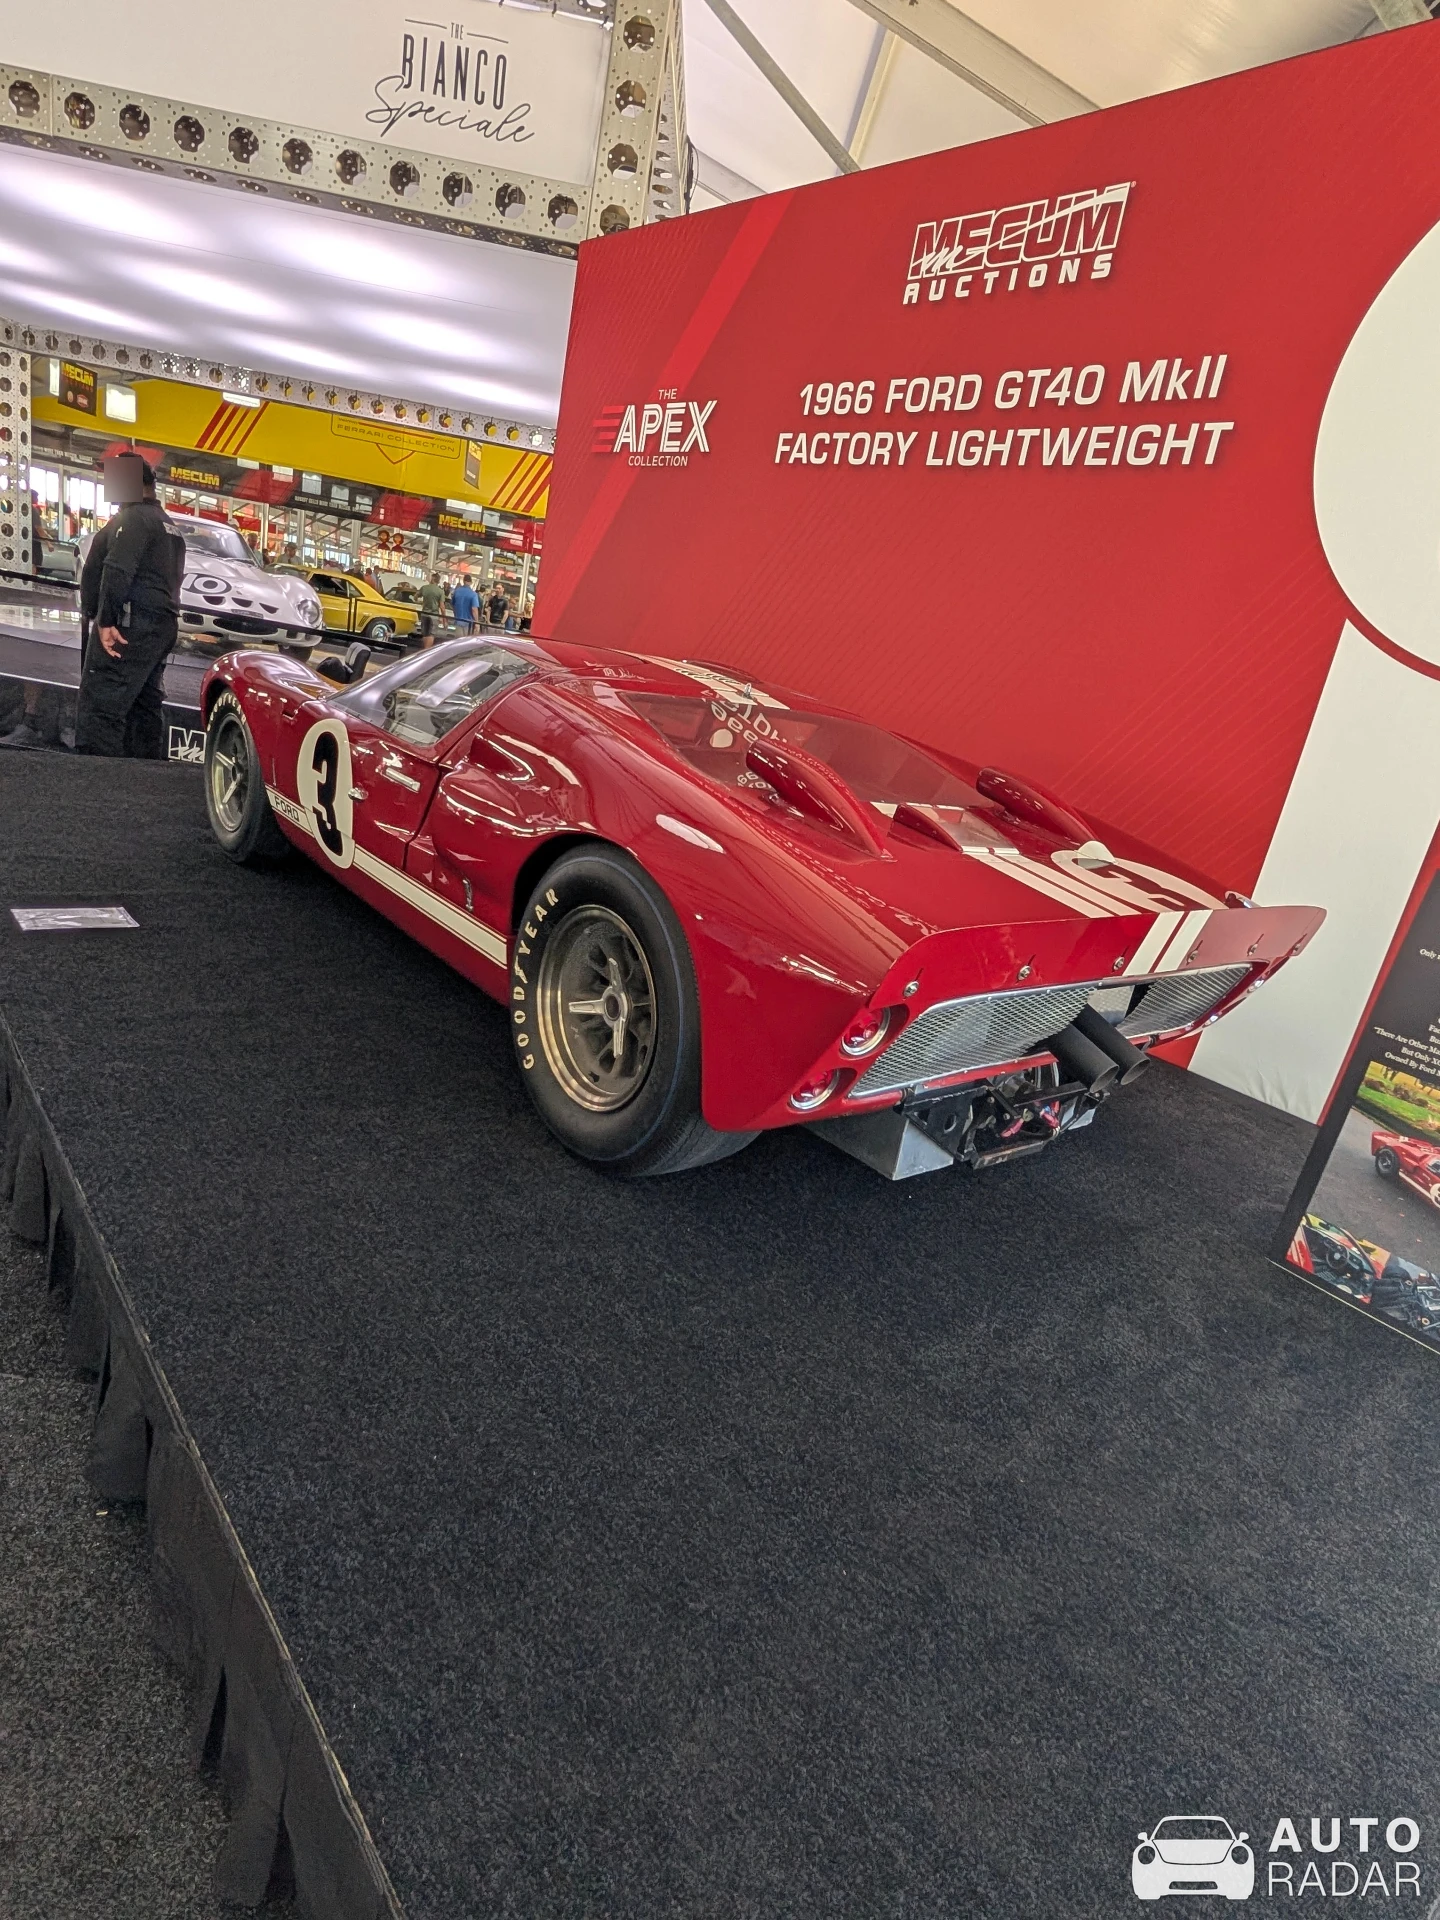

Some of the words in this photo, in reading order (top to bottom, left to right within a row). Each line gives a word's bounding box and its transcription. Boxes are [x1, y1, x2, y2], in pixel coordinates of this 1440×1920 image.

[450, 22, 464, 40] THE
[401, 33, 507, 110] BIANCO
[365, 75, 535, 142] Speciale
[907, 181, 1131, 281] MECUM
[902, 252, 1114, 305] AUCTIONS
[658, 388, 678, 400] THE
[800, 380, 875, 416] 1966
[884, 373, 983, 413] FORD
[994, 363, 1106, 409] GT40
[337, 423, 384, 438] FERRARI
[387, 434, 455, 453] COLLECTION
[612, 399, 718, 453] APEX
[774, 431, 918, 466] FACTORY
[925, 421, 1235, 467] LIGHTWEIGHT
[170, 466, 220, 486] MECUM
[628, 455, 688, 467] COLLECTION
[438, 513, 486, 534] MECUM
[274, 796, 300, 822] FORD
[311, 731, 343, 857] 3
[512, 888, 560, 1070] GOODYEAR
[1395, 1034, 1408, 1044] Are
[1408, 1039, 1429, 1051] Other
[1401, 1046, 1415, 1057] But
[1414, 1052, 1431, 1063] Only
[1385, 1051, 1410, 1065] Owned
[1409, 1060, 1419, 1069] By
[1419, 1064, 1437, 1075] Ford
